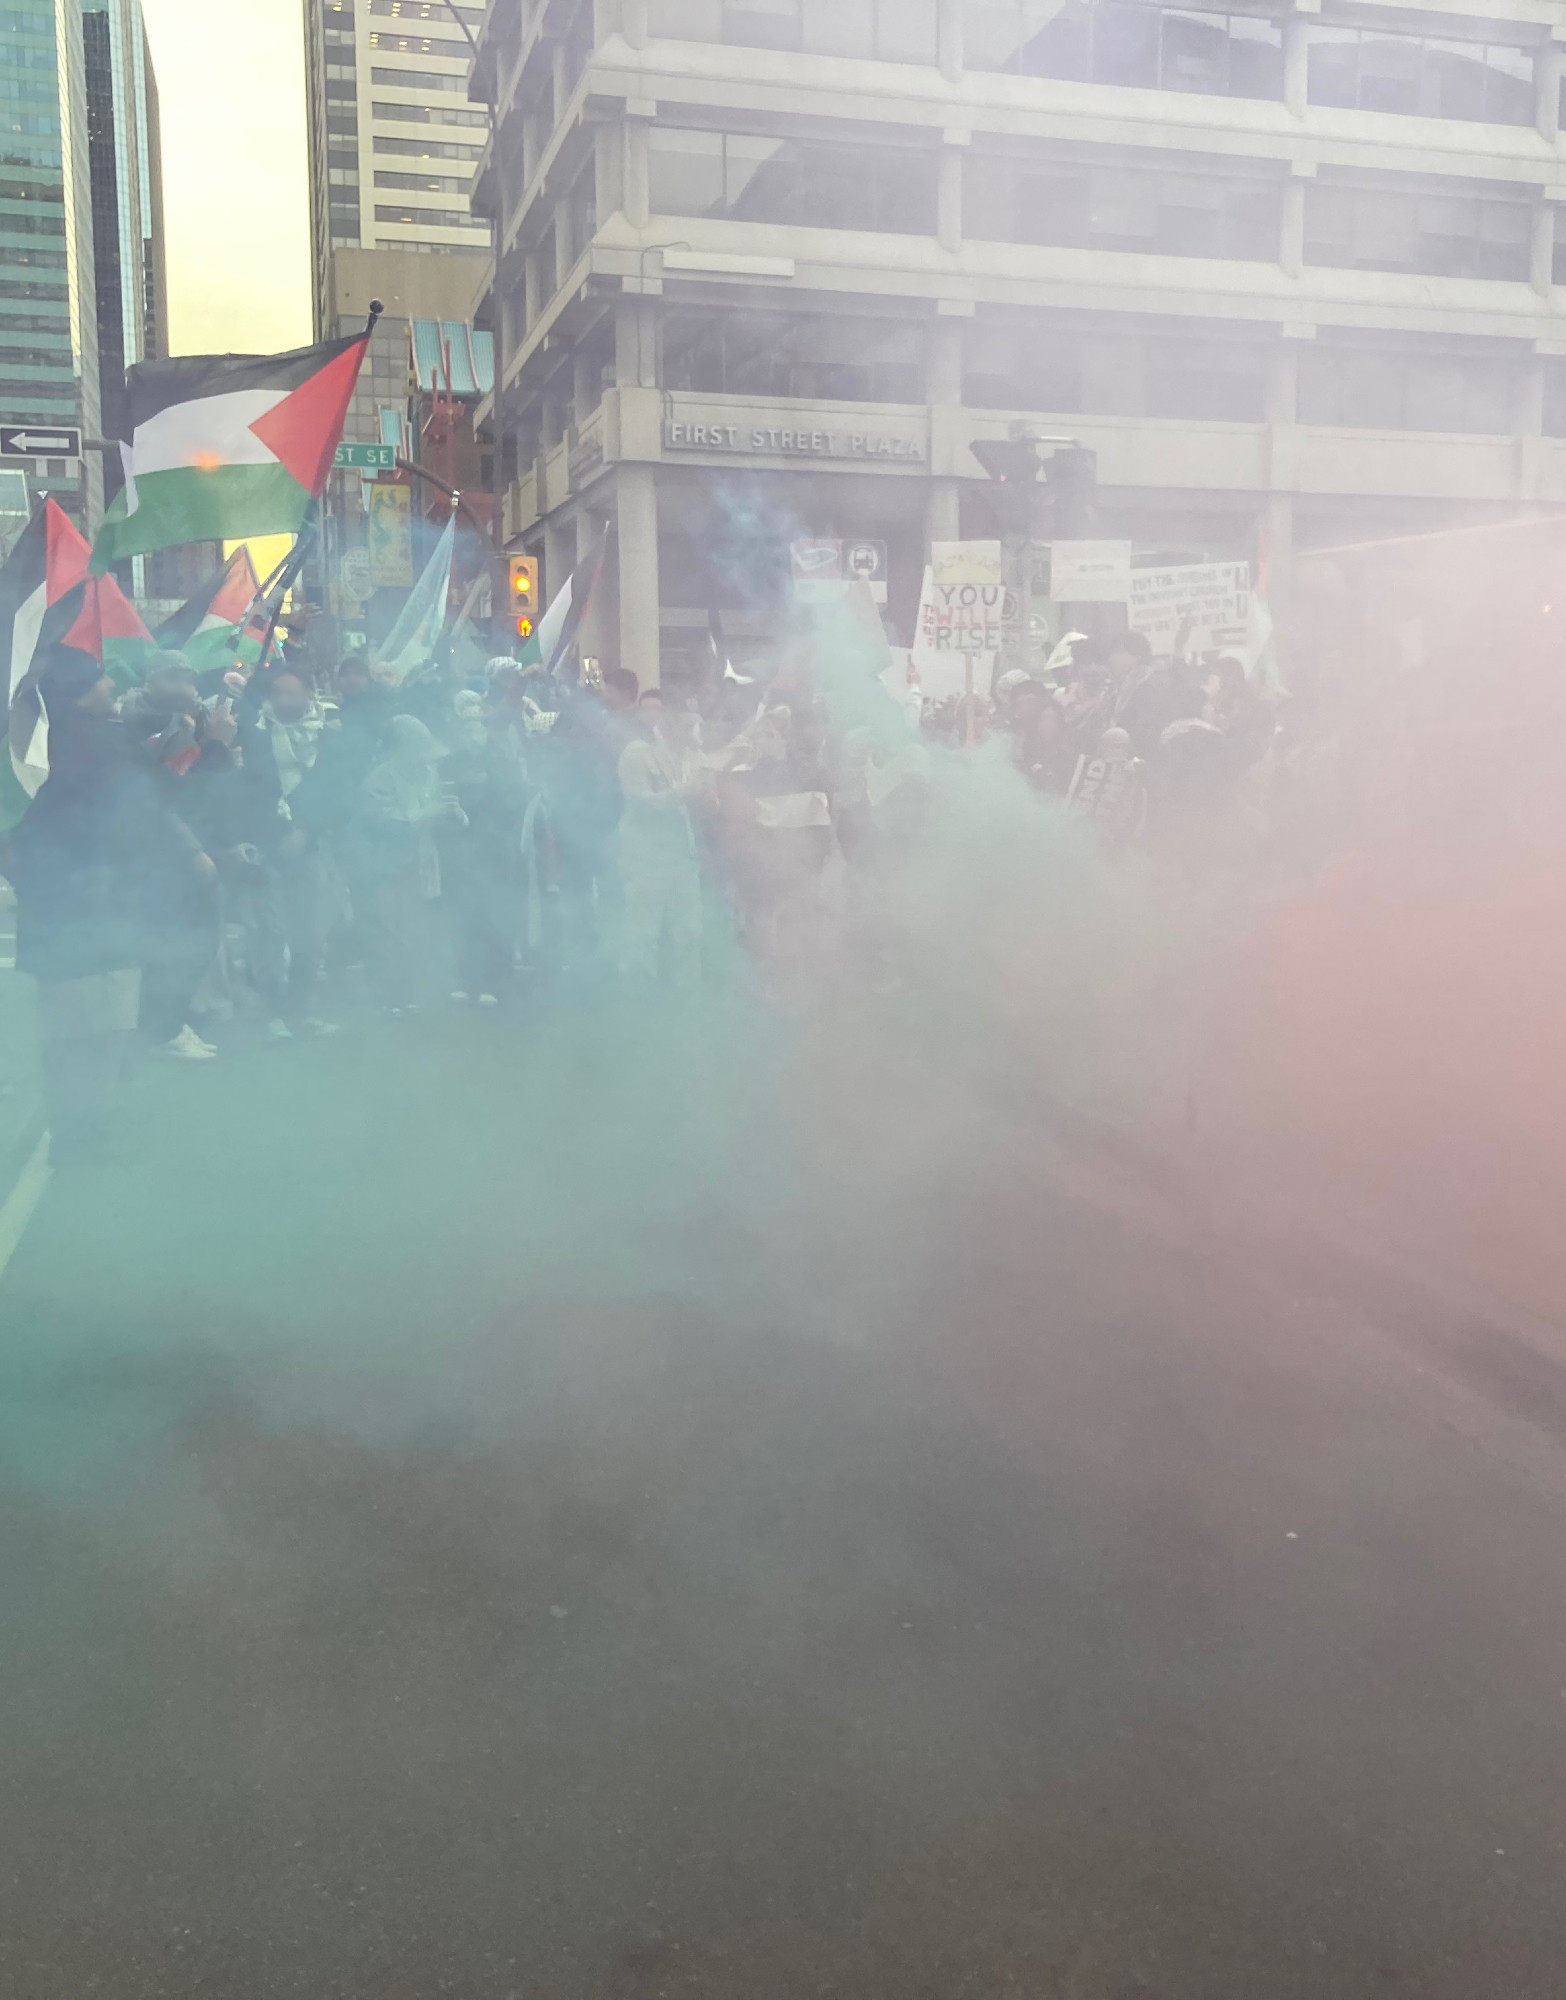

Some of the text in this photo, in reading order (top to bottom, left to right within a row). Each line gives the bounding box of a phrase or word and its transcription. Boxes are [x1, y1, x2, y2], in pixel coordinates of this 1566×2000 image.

[670, 422, 922, 455] FIRST STREET PLAZA
[334, 447, 389, 464] ST SE
[939, 585, 999, 607] YOU
[936, 605, 1000, 626] WILL
[935, 626, 1000, 651] RISE
